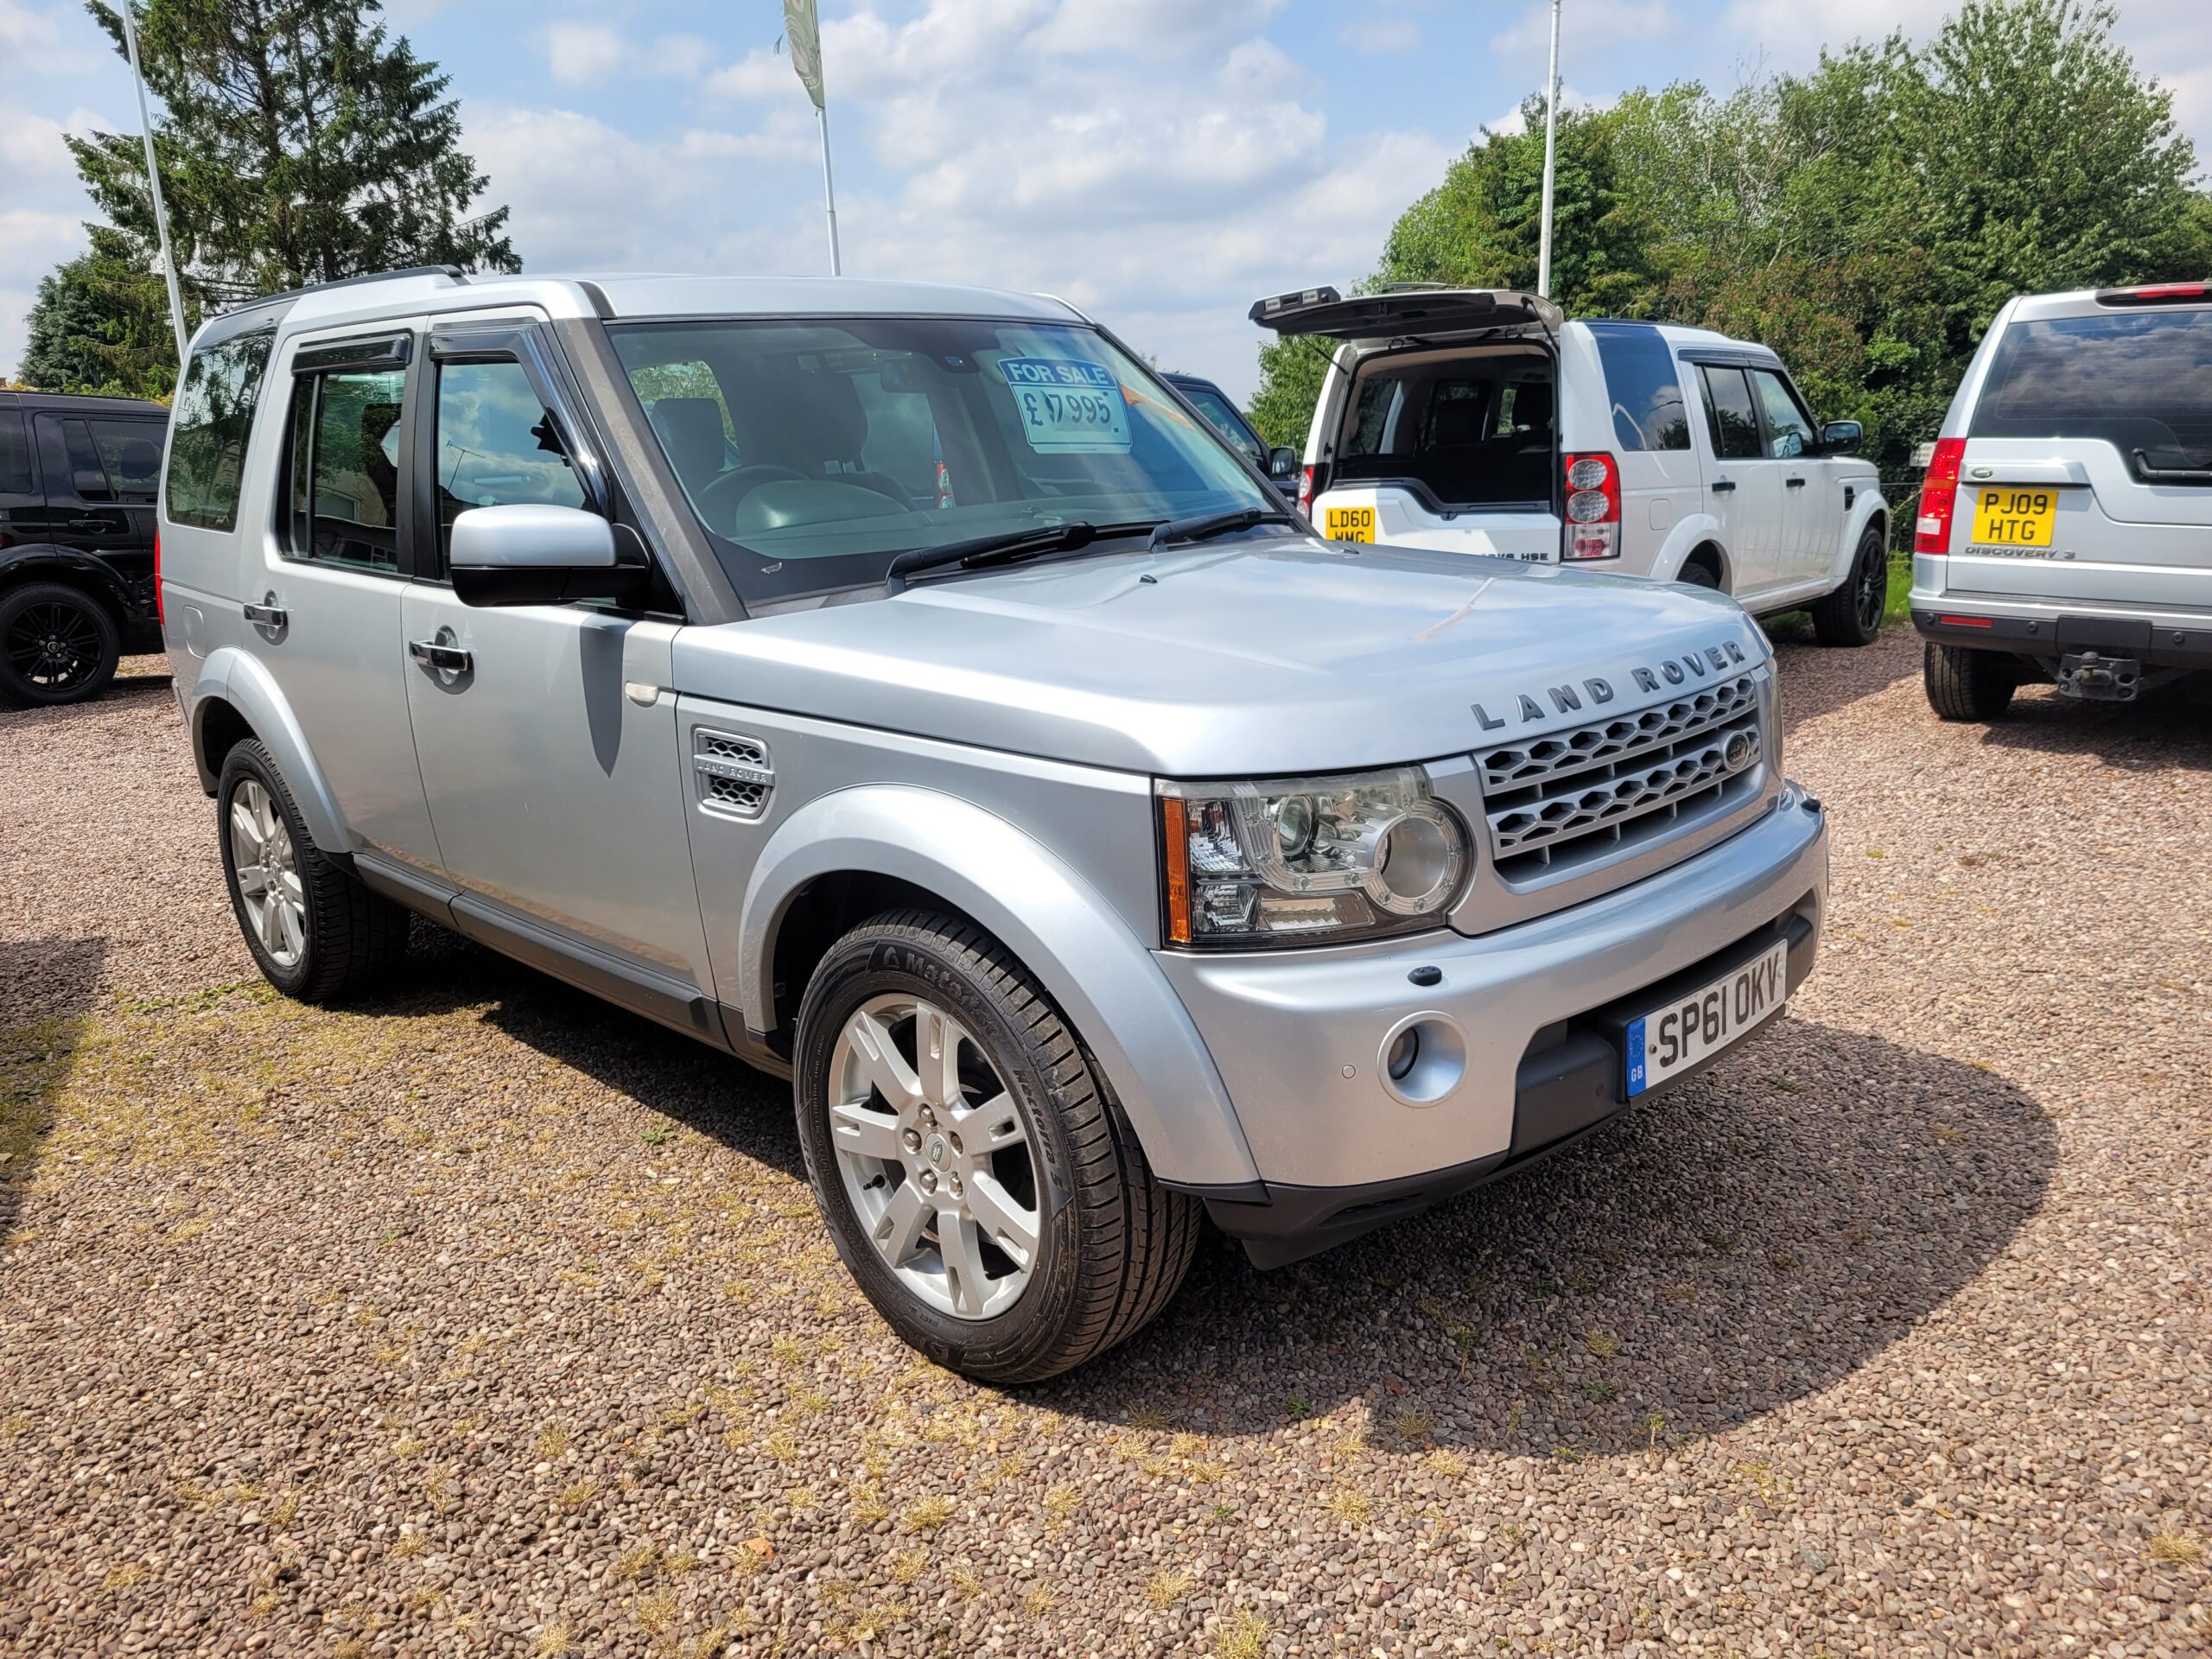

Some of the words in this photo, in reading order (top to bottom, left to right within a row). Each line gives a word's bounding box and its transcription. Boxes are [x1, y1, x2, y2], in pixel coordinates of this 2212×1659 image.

[1007, 363, 1057, 383] FOR
[1056, 365, 1109, 385] SALE
[1983, 493, 2048, 516] PJ09
[1329, 510, 1370, 528] LD60
[1988, 518, 2036, 541] HTG
[1964, 546, 2058, 559] DISCOVERY
[2063, 551, 2075, 560] 3
[1471, 677, 1614, 731] LAND
[1630, 639, 1745, 693] ROVER
[697, 760, 724, 774] LAND
[729, 766, 766, 783] ROVER
[1658, 984, 1727, 1068] SP61
[1735, 951, 1779, 1026] OKV
[1630, 1065, 1643, 1083] GB
